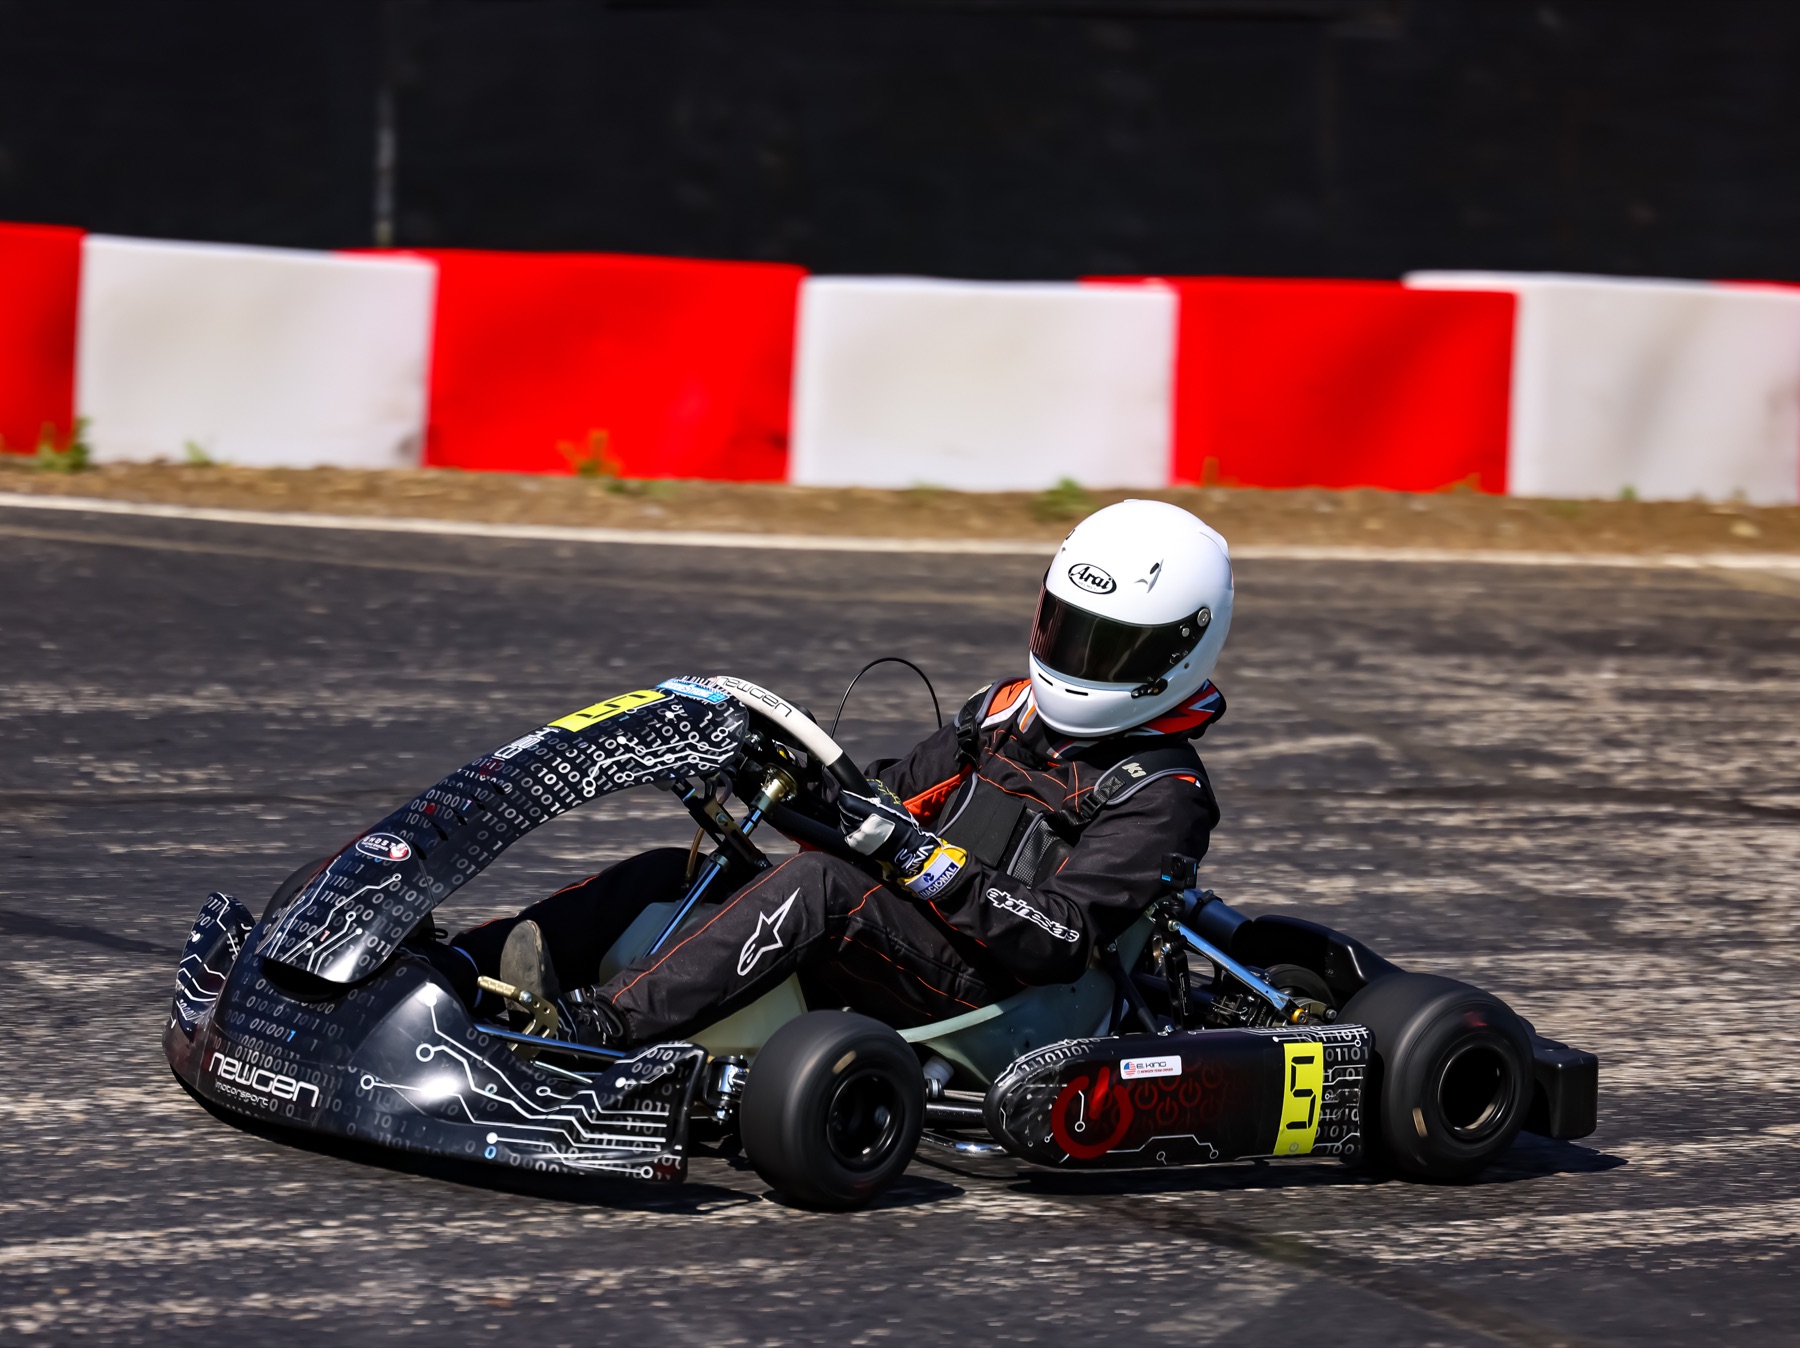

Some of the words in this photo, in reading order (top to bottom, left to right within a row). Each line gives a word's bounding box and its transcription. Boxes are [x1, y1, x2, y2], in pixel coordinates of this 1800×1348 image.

[1070, 566, 1112, 589] Arai
[1121, 762, 1147, 778] K1
[986, 888, 1080, 942] alpinestars
[1285, 1055, 1317, 1130] 5
